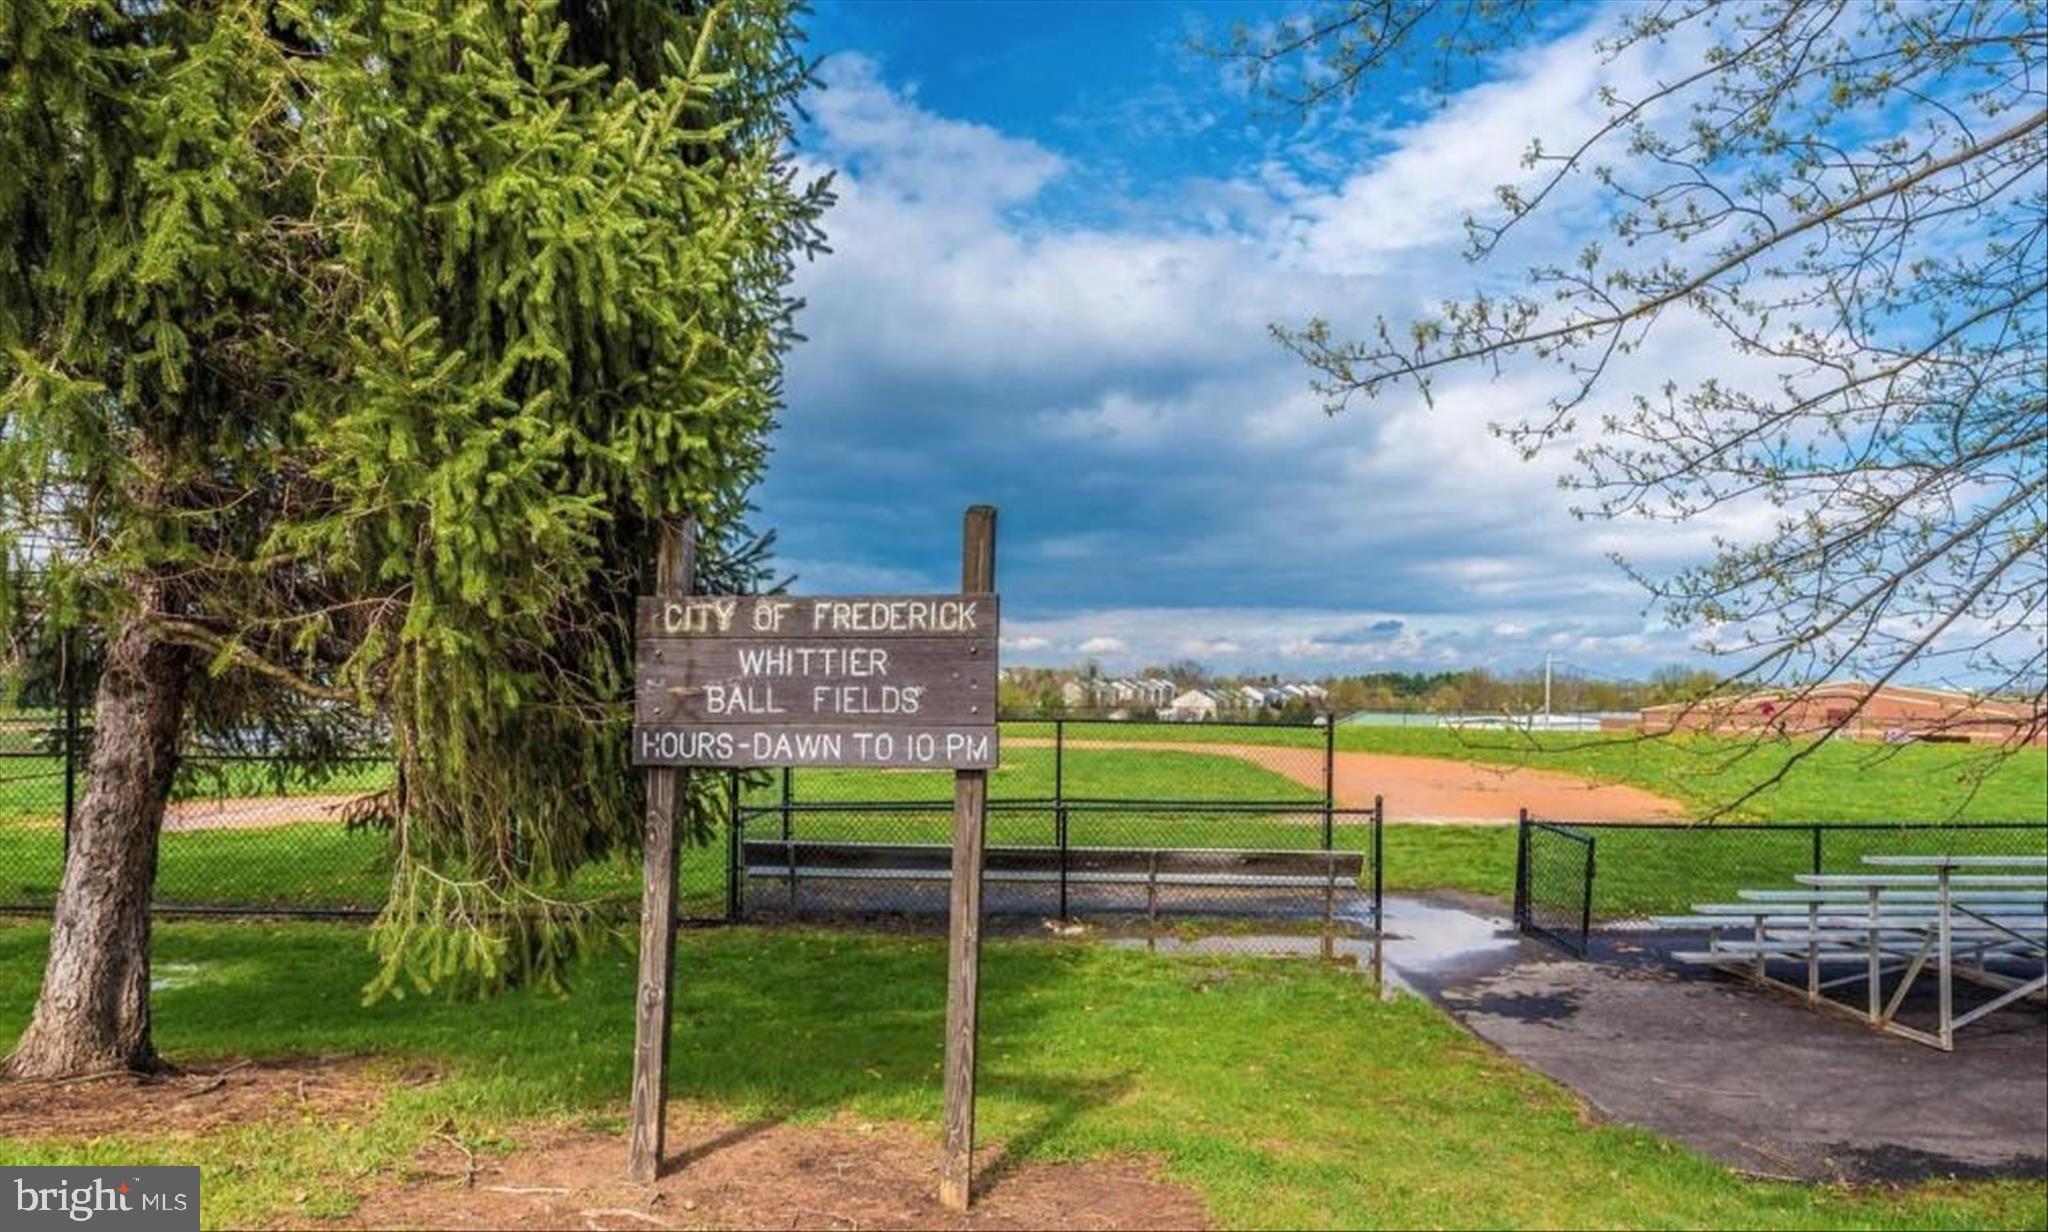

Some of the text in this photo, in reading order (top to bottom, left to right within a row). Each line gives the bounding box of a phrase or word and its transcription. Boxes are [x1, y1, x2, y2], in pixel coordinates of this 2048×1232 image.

[664, 602, 977, 632] CITY OF FREDERICK
[738, 649, 888, 676] WHITTIER
[707, 686, 921, 714] BALL FIELDS
[853, 732, 892, 760] TO
[947, 733, 988, 761] PM
